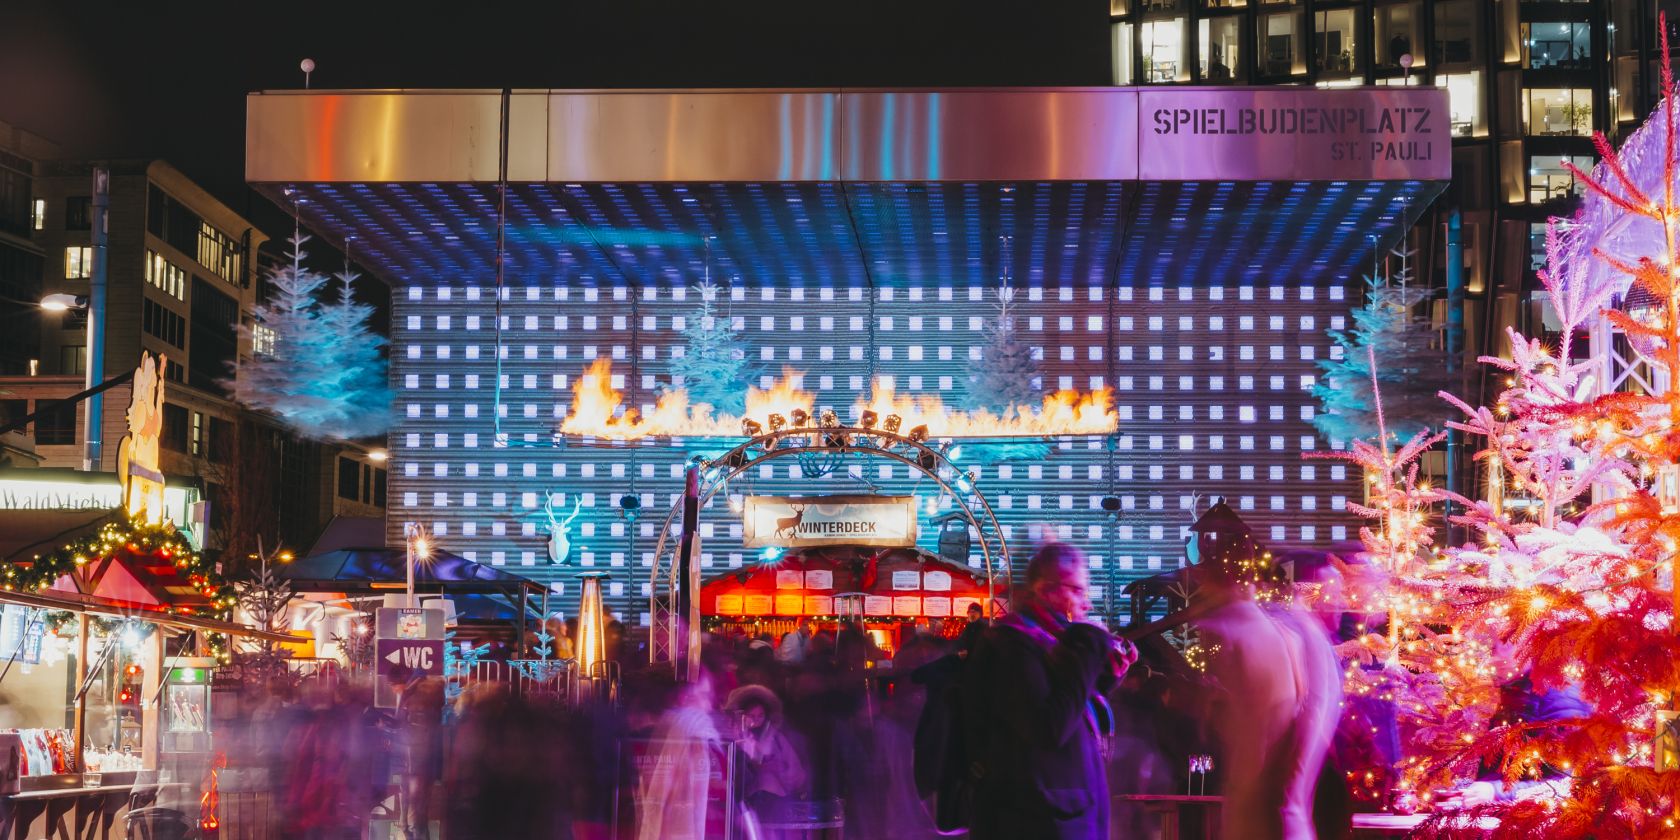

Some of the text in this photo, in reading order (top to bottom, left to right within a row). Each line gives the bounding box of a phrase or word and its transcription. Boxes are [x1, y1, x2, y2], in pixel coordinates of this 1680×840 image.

[1153, 108, 1432, 135] SPIELBUDENPLATZ
[1331, 141, 1432, 161] ST. PAULI
[798, 521, 877, 534] WINTERDECK
[403, 646, 433, 669] WC
